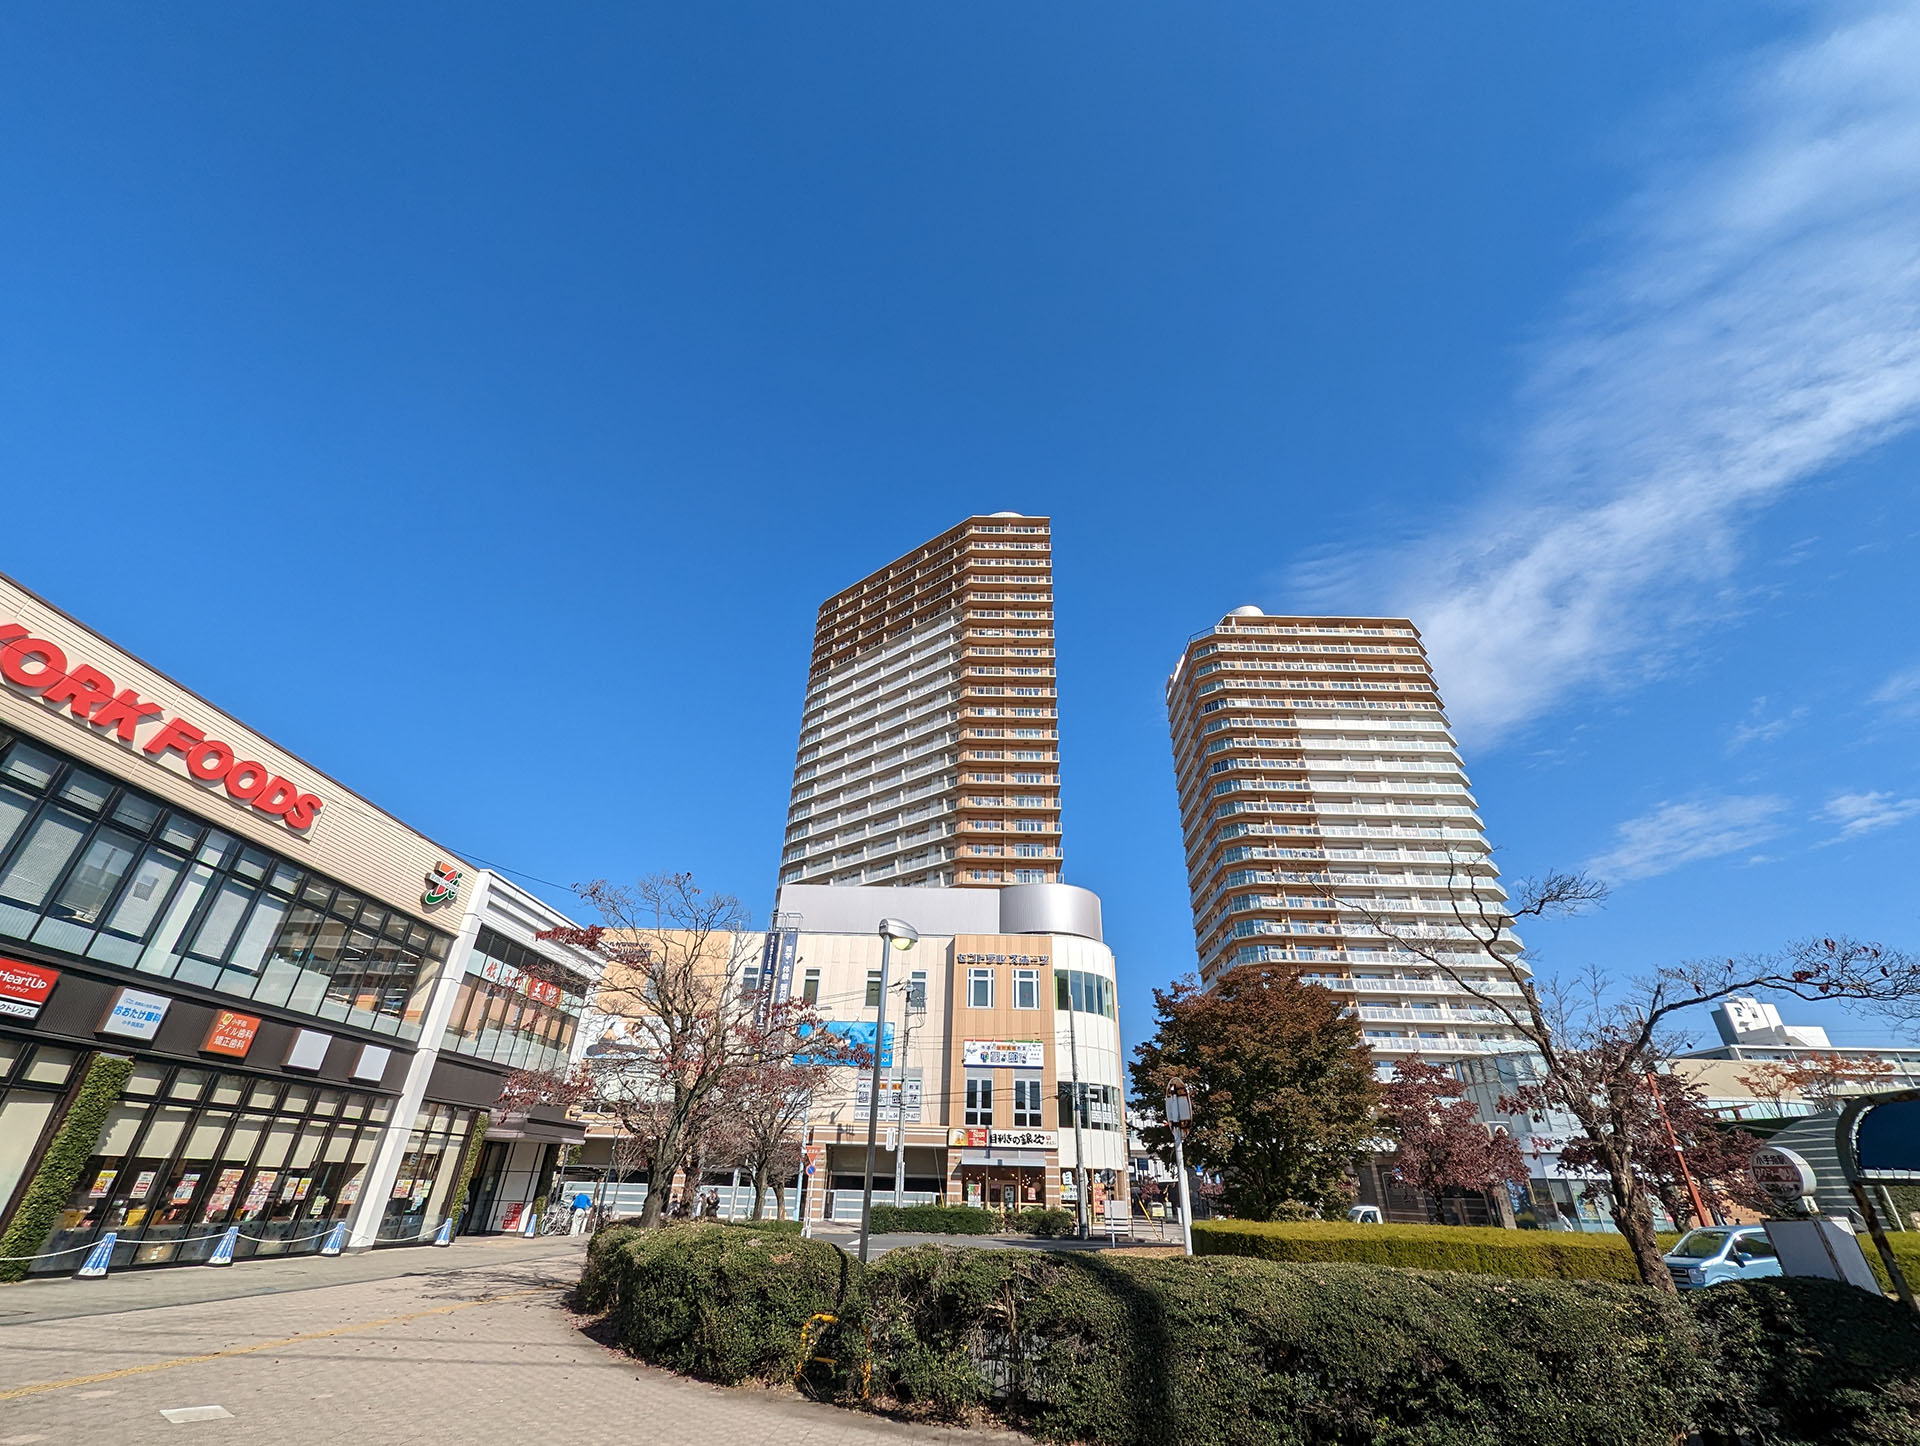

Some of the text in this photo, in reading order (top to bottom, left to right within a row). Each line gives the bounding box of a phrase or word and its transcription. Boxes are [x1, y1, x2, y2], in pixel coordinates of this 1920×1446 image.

[143, 717, 323, 830] FOODS
[215, 1024, 255, 1040] アイル歯科
[990, 1132, 1046, 1146] 目利きの銀次
